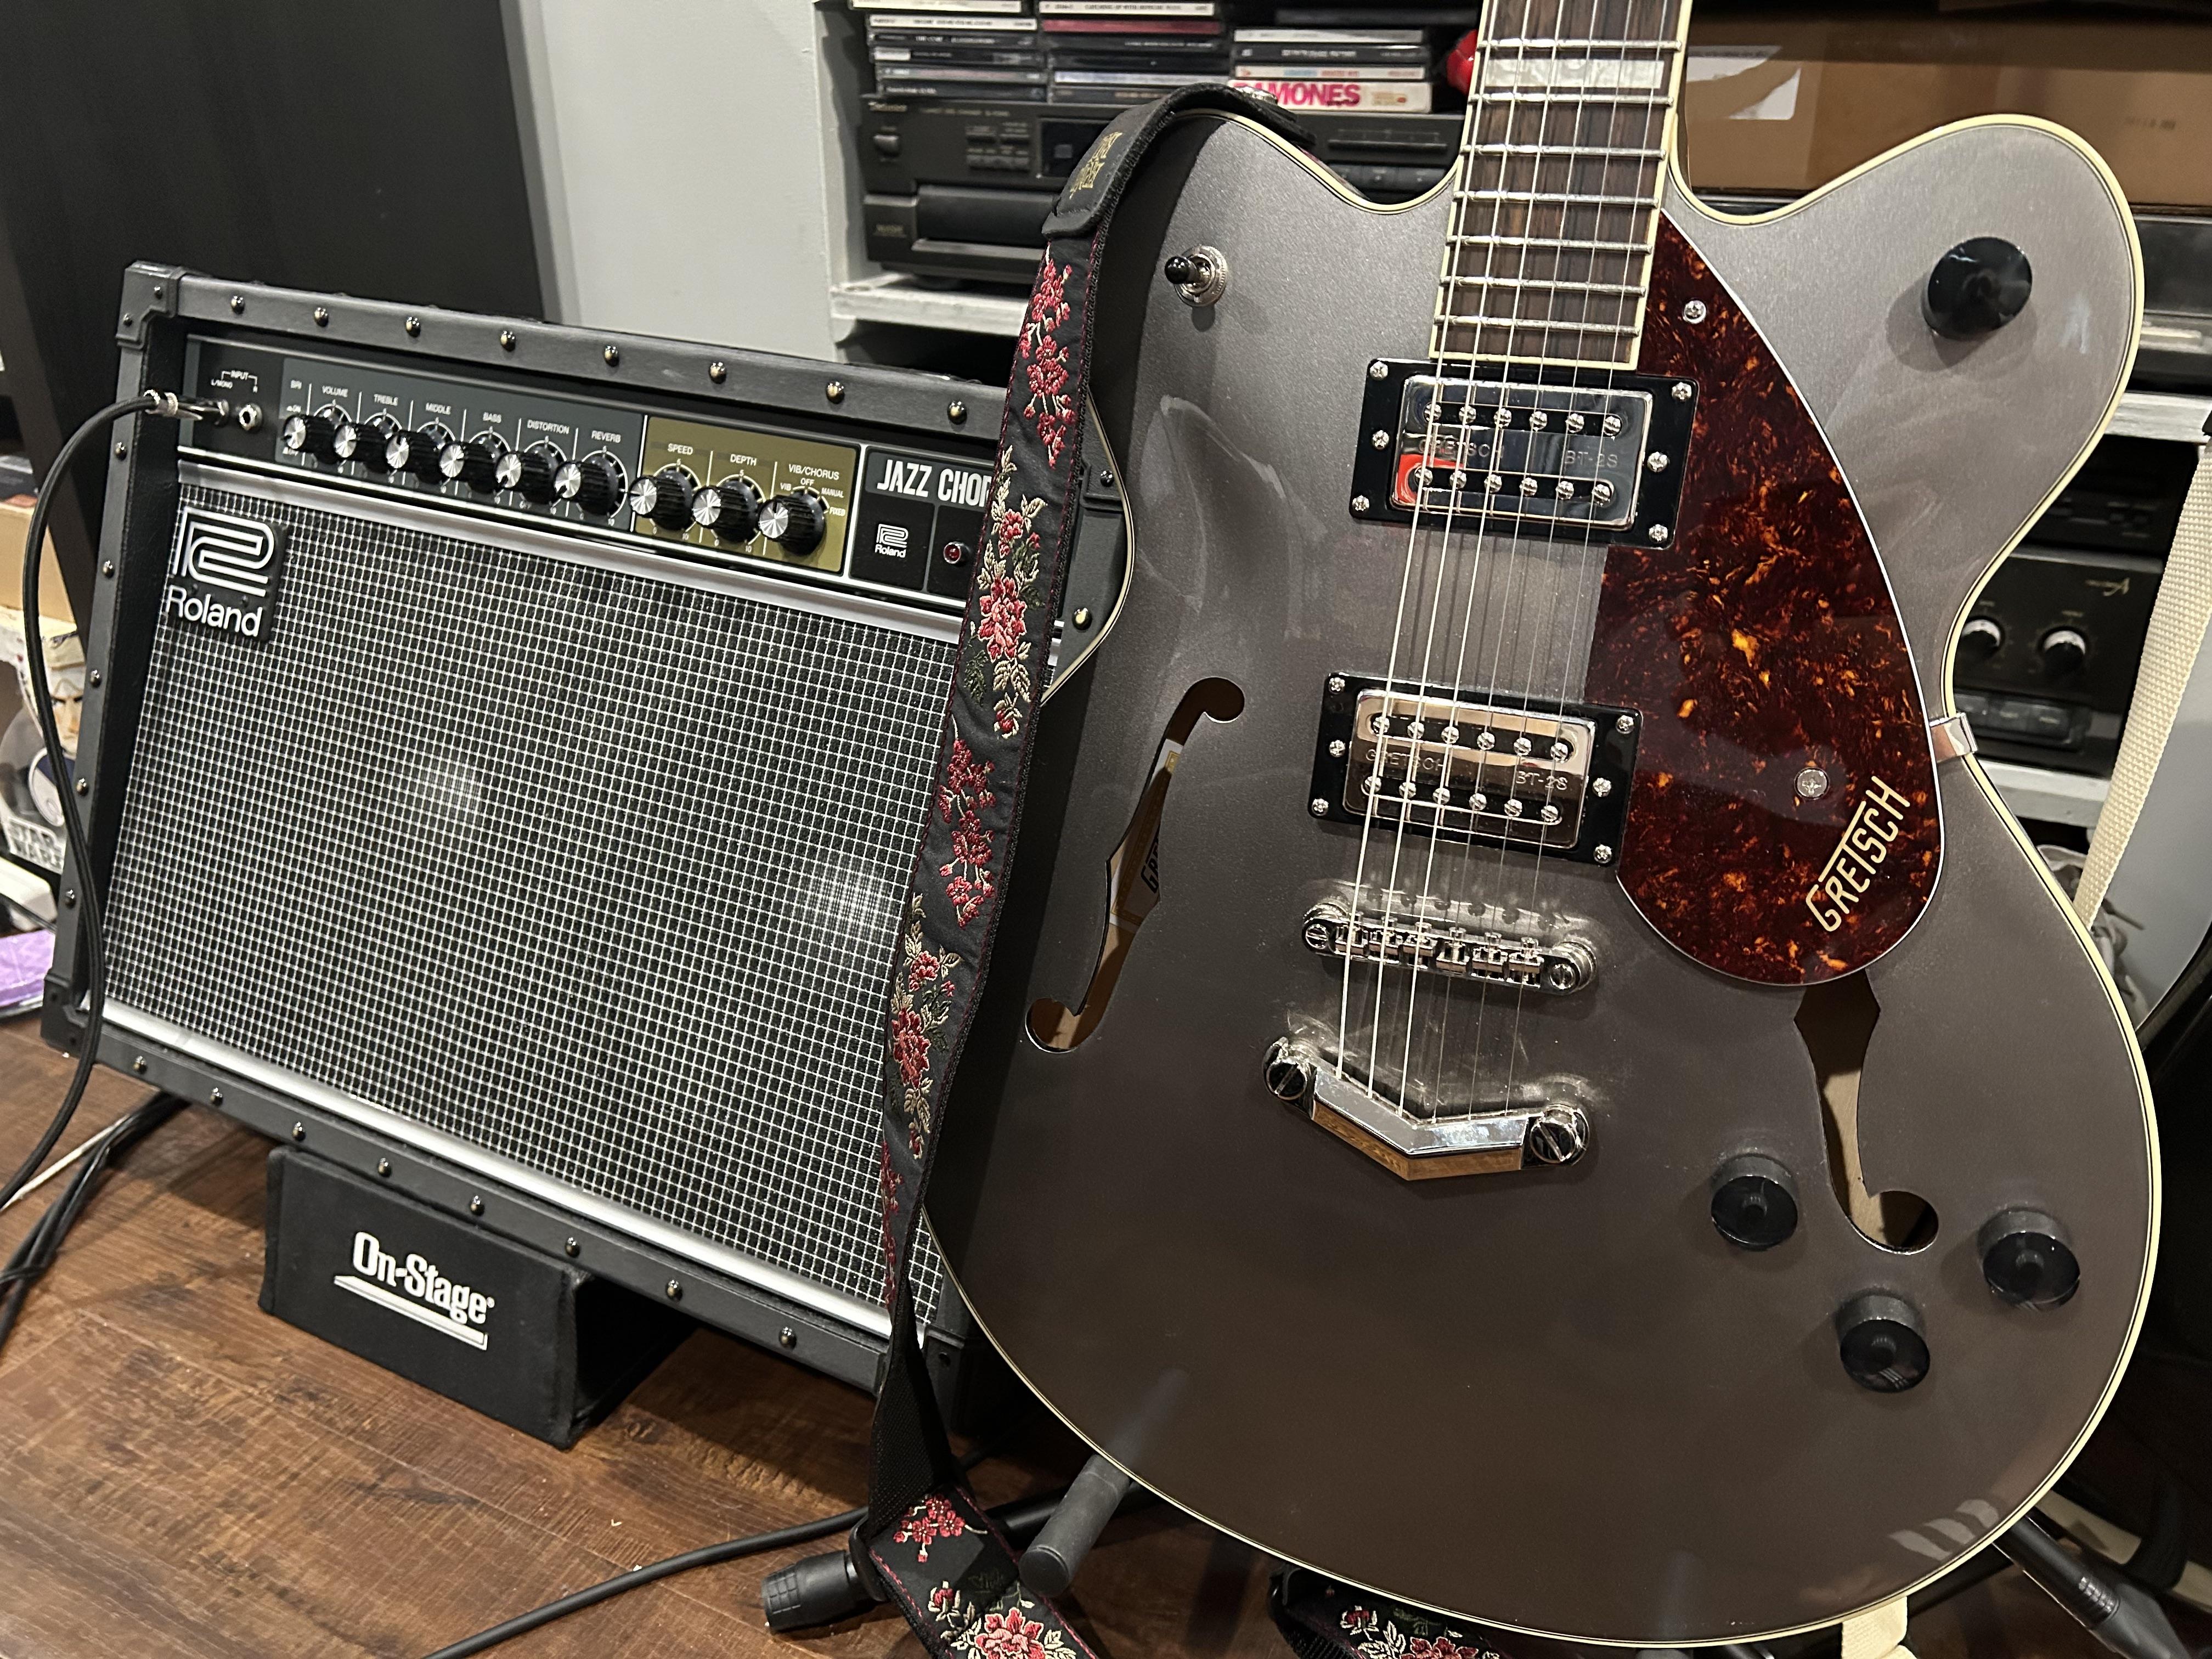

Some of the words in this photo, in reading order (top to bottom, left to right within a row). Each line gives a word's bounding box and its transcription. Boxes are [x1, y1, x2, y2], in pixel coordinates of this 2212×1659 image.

[1234, 82, 1361, 106] MONES
[230, 370, 249, 380] INPUT
[322, 385, 348, 398] VOLUME
[374, 393, 399, 407] TREBLE
[426, 402, 452, 415] MIDDLE
[483, 411, 502, 424] BASS
[527, 419, 569, 435] DISTORTION
[591, 430, 622, 444] REVERB
[667, 443, 693, 455] SPEED
[730, 453, 757, 466] DEPTH
[788, 464, 840, 481] VIB/CHORUS
[780, 482, 792, 491] VIB
[800, 477, 815, 486] OFF
[877, 459, 933, 498] JAZZ
[938, 469, 992, 507] CHOR
[821, 487, 844, 498] MANUAL
[829, 506, 846, 517] FIXED
[874, 544, 906, 558] Roland
[165, 584, 263, 637] Roland
[1805, 775, 1911, 932] GRETSCH
[352, 1231, 488, 1324] On-Stage
